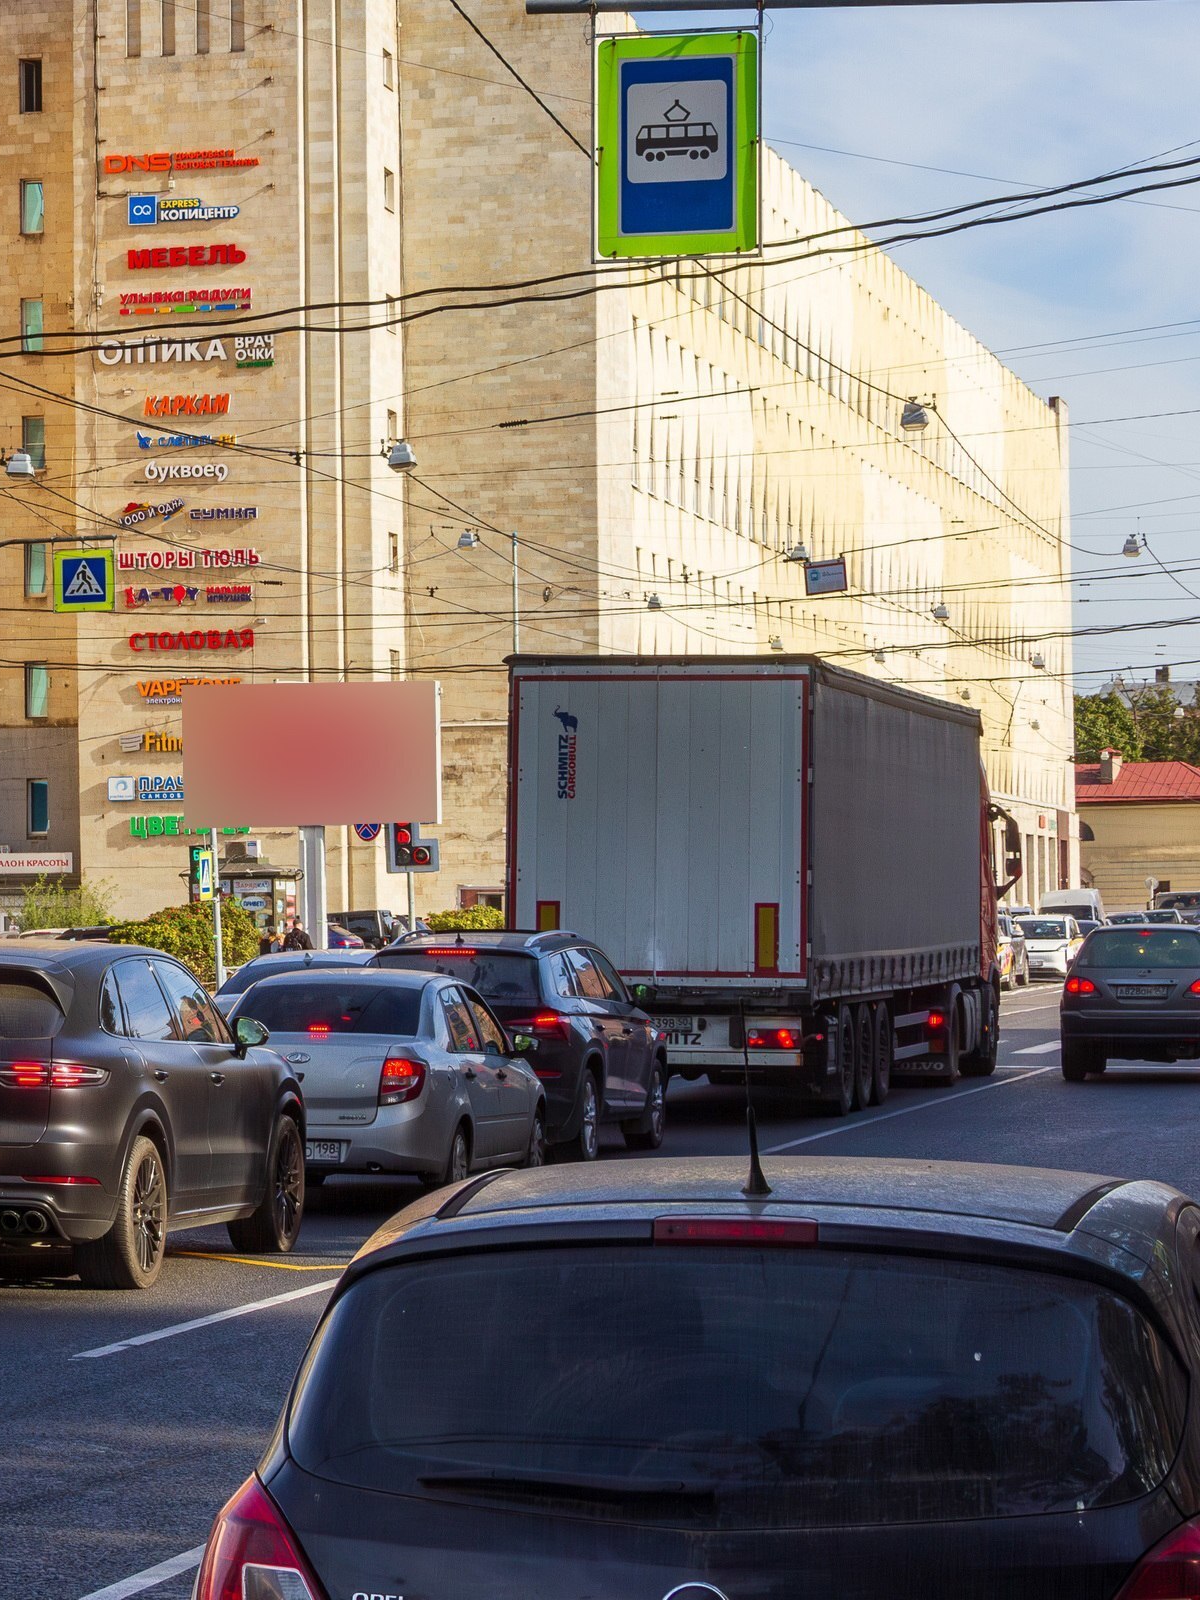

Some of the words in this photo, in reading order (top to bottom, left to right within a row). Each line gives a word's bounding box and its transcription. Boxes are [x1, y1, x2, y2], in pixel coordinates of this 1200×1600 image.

[104, 153, 171, 174] DNS
[174, 150, 225, 161] ЦИФРОВАЯ
[227, 149, 235, 158] И
[174, 159, 216, 170] БЫТОВАЯ
[219, 157, 260, 168] ТЕХНИКА
[160, 199, 199, 209] EXPRESS
[160, 207, 238, 221] КОПИЦЕНТР
[128, 243, 247, 269] МЕБЕЛЬ
[120, 291, 185, 304] УЛЫБКА
[187, 287, 253, 302] РАДУГИ
[234, 334, 274, 348] ВРАЧ
[97, 338, 227, 366] ОПТИКА
[234, 348, 274, 361] ОЧКИ
[144, 393, 231, 417] КАРКАМ
[144, 461, 228, 483] буквоед
[148, 509, 156, 519] И
[157, 498, 185, 516] ОДНА
[189, 507, 258, 520] СУМКА
[118, 551, 195, 570] ШТОРЫ
[200, 548, 261, 568] ТЮЛЬ
[206, 585, 253, 594] МАГАЗИН
[206, 593, 253, 603] ИГРУШЕК
[128, 629, 254, 652] СТОЛОВАЯ
[137, 678, 242, 697] VAPE
[146, 697, 182, 705] электрон
[144, 731, 183, 753] Fitn
[558, 735, 568, 799] SCHMITZ
[568, 735, 576, 799] CARGOBULL
[26, 859, 69, 868] КРАСОТЫ
[316, 1143, 336, 1154] 198
